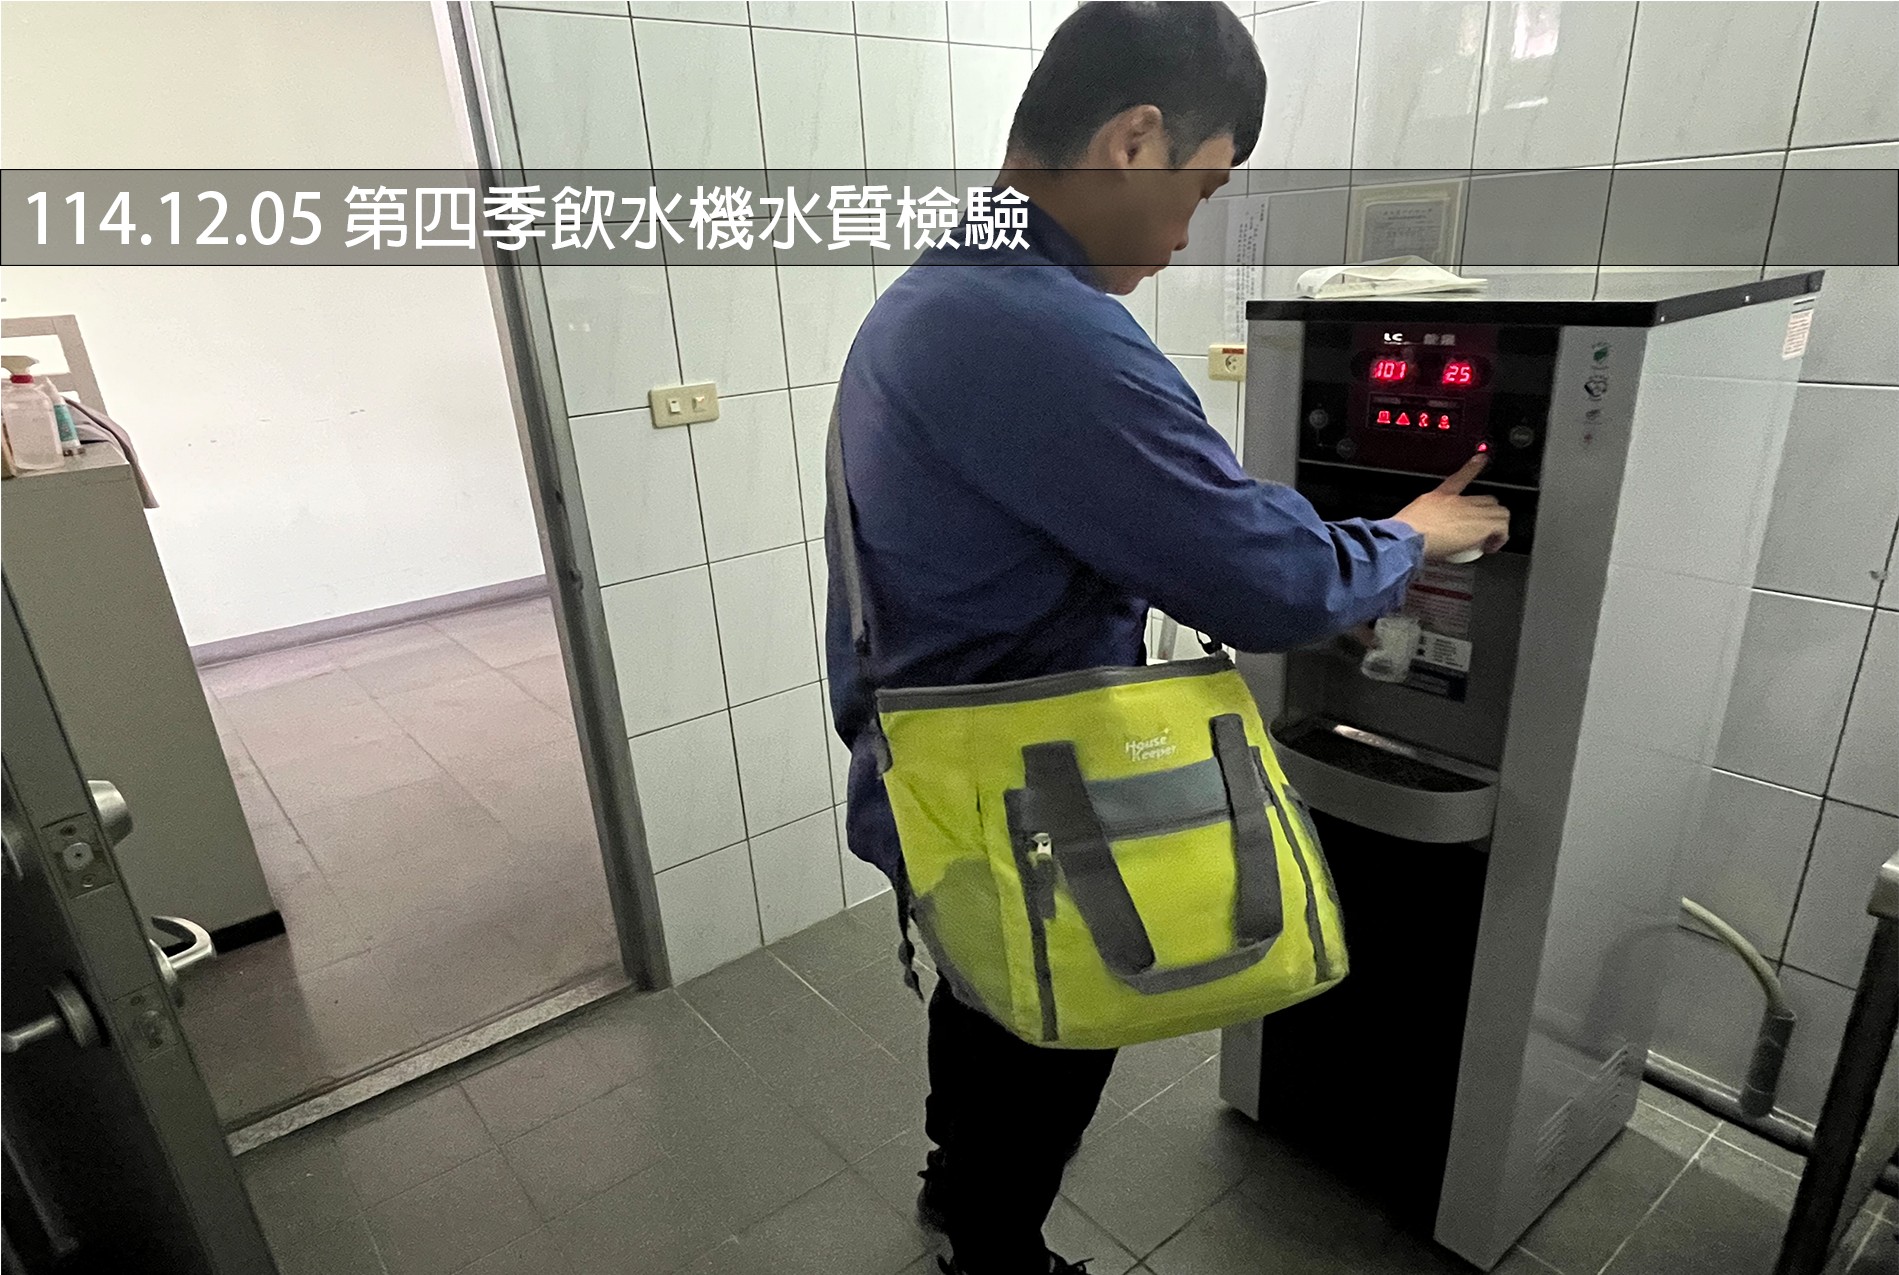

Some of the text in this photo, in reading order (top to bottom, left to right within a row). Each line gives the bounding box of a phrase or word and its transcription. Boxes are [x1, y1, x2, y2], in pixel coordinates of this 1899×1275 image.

[1374, 361, 1471, 383] 101 25
[1125, 736, 1168, 754] House
[1131, 745, 1177, 762] Keeper
